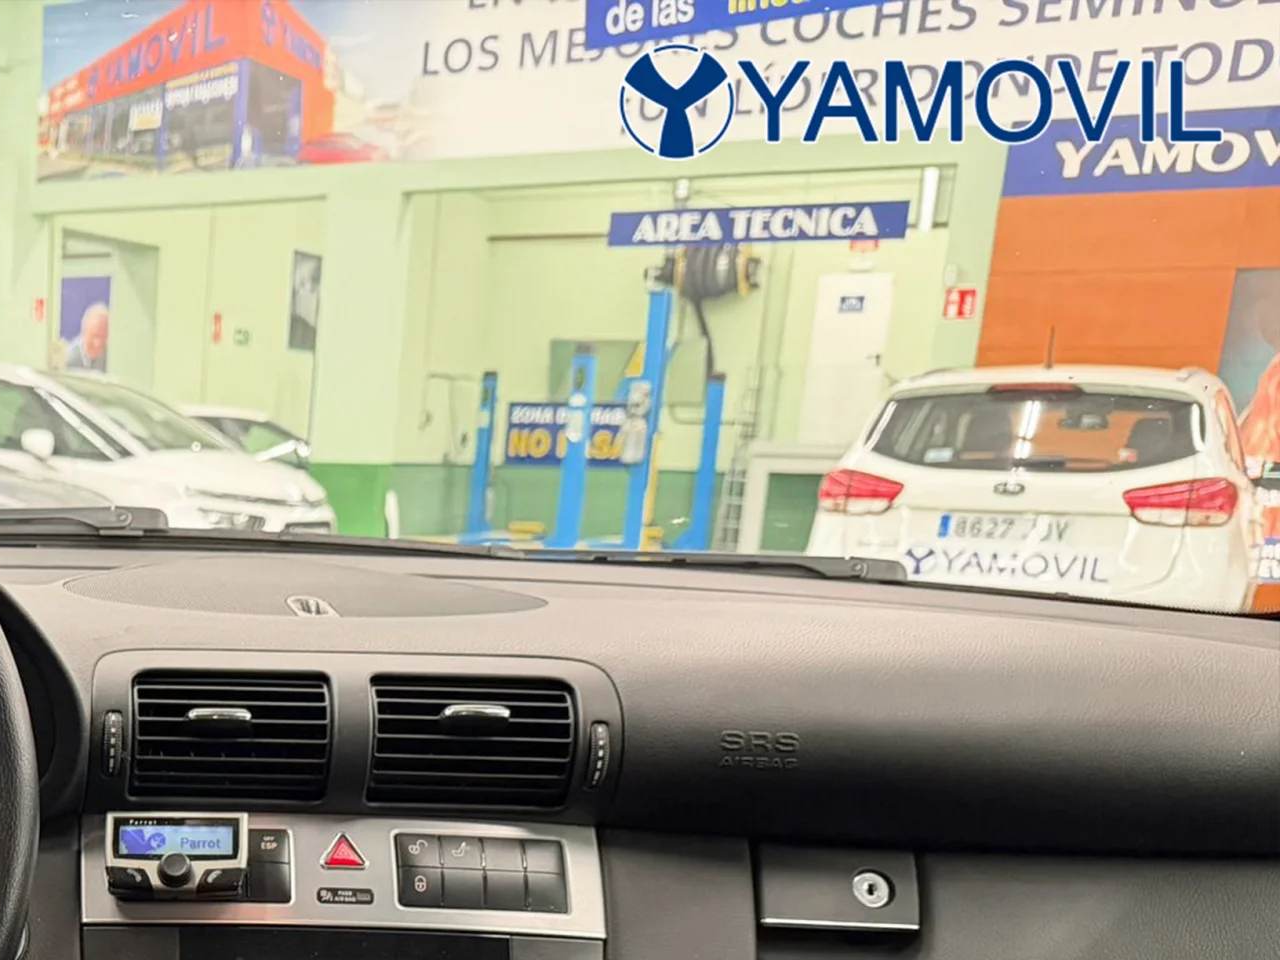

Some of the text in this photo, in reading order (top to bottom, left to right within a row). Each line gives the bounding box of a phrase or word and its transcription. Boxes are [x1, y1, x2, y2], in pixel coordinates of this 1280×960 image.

[606, 0, 644, 35] de
[422, 34, 500, 76] LOS
[1141, 38, 1280, 86] TOD
[632, 206, 878, 243] AREA TECNICA
[720, 730, 800, 751] SRS
[180, 837, 221, 850] Parrot
[261, 842, 278, 850] ESP
